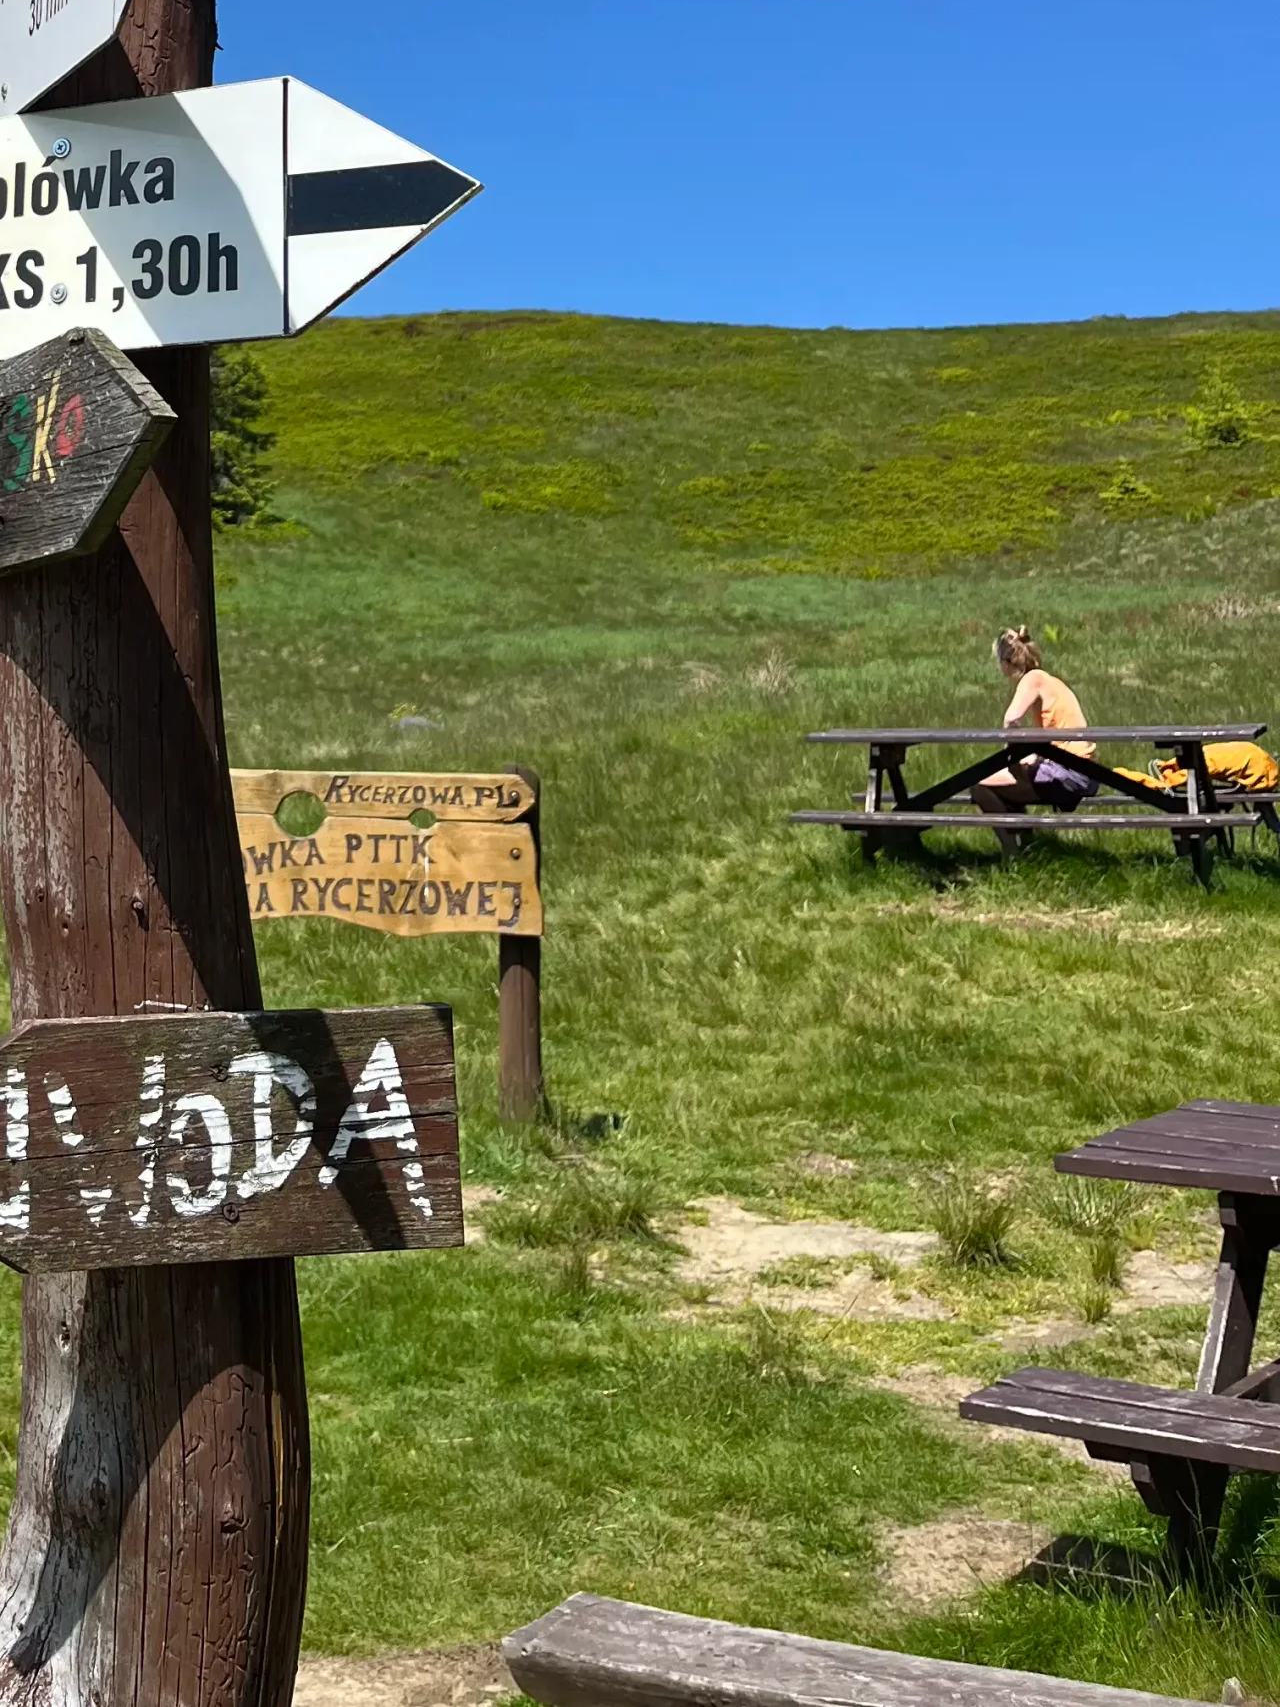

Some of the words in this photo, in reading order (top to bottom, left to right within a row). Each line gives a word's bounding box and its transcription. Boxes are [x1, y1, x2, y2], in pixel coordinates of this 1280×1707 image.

[76, 231, 240, 313] 1,30h
[241, 837, 326, 876] WKA
[345, 833, 438, 865] PTTK
[291, 877, 524, 929] RYCERZOWEJ
